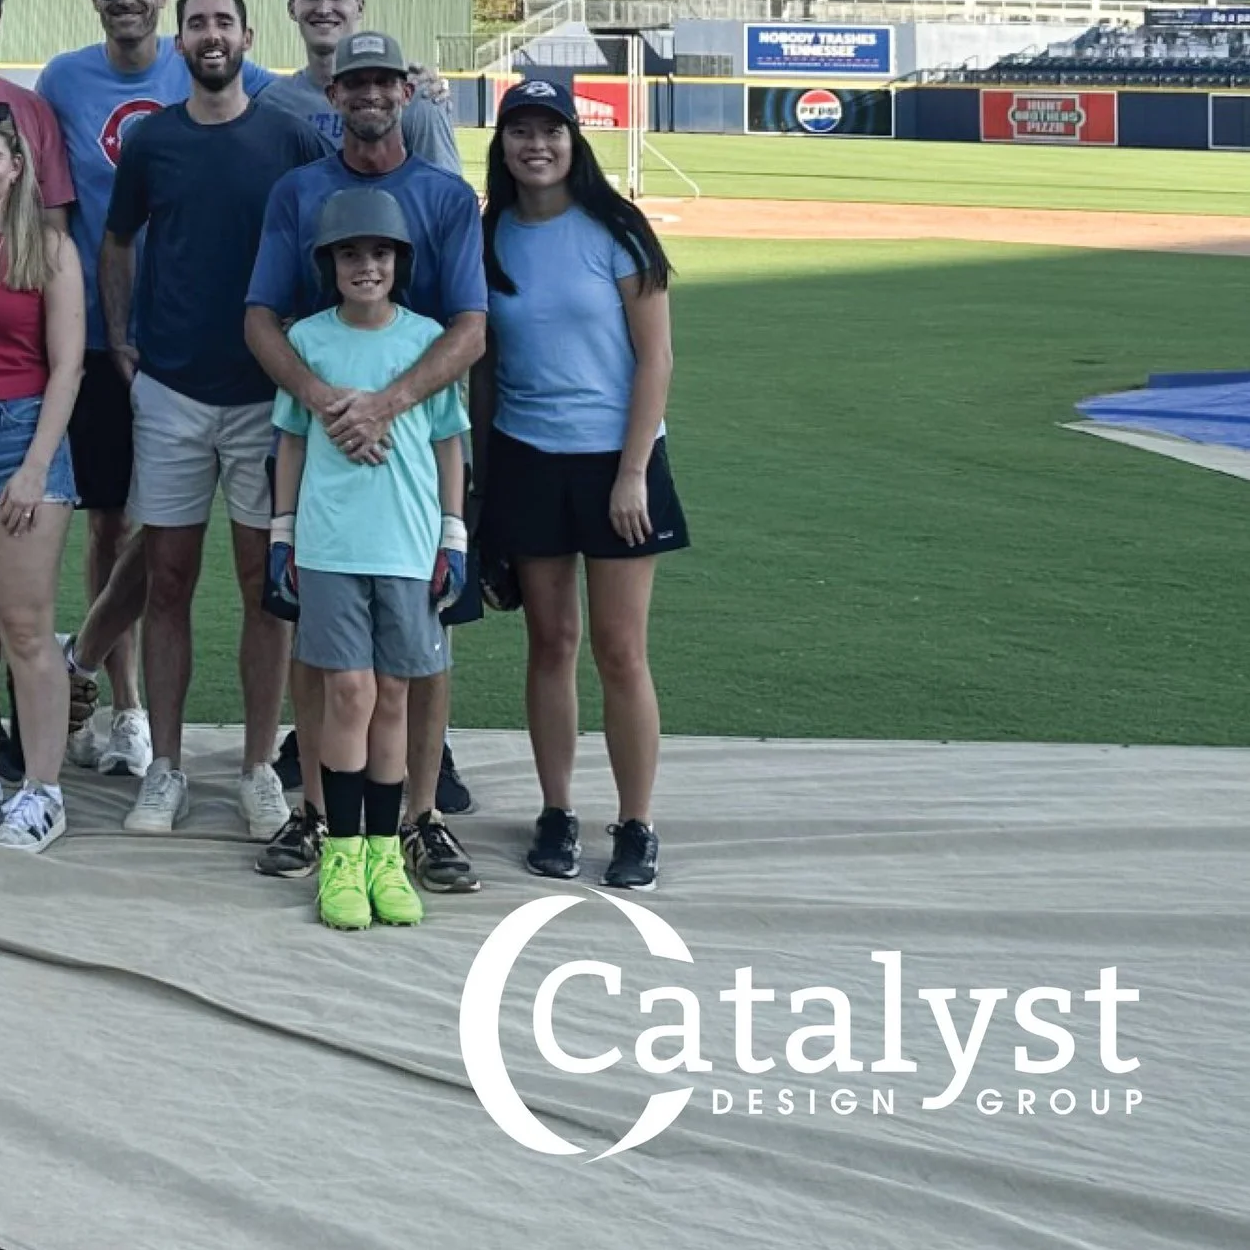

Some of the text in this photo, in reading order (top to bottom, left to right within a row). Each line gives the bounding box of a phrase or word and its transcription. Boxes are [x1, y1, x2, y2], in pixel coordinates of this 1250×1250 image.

[758, 32, 878, 45] NOBODY TRASHES
[781, 44, 859, 57] TENNESSEE
[1014, 111, 1078, 122] BROTHERS
[1026, 122, 1065, 133] PIZZA
